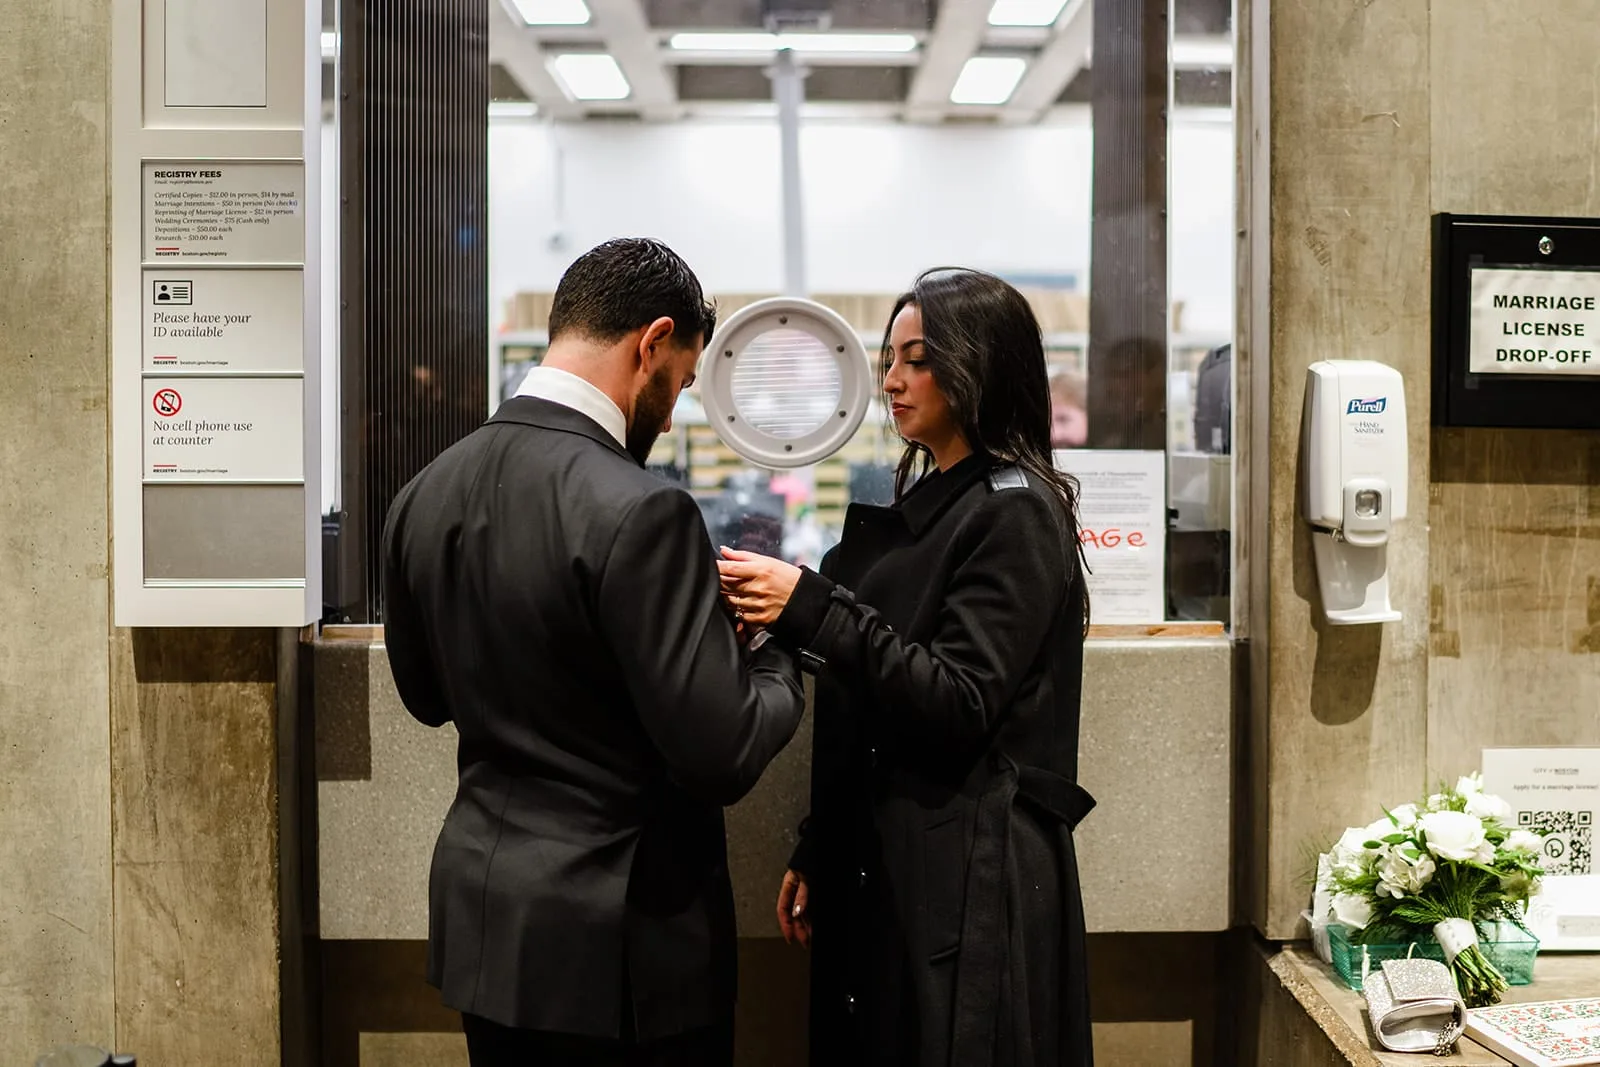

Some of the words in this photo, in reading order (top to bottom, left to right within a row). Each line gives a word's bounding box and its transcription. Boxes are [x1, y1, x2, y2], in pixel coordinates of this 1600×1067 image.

[254, 217, 269, 225] only)
[1493, 295, 1595, 310] MARRIAGE
[153, 313, 189, 323] Please
[193, 313, 221, 323] have
[224, 314, 251, 326] your
[153, 327, 167, 337] ID
[170, 326, 224, 337] available
[1503, 322, 1585, 336] LICENSE
[1496, 349, 1592, 363] DROP-OFF
[1351, 401, 1383, 412] Purell
[153, 421, 169, 431] No
[172, 420, 191, 431] cell
[195, 420, 230, 434] phone
[234, 423, 253, 431] use
[153, 436, 164, 445] at
[168, 436, 213, 445] counter
